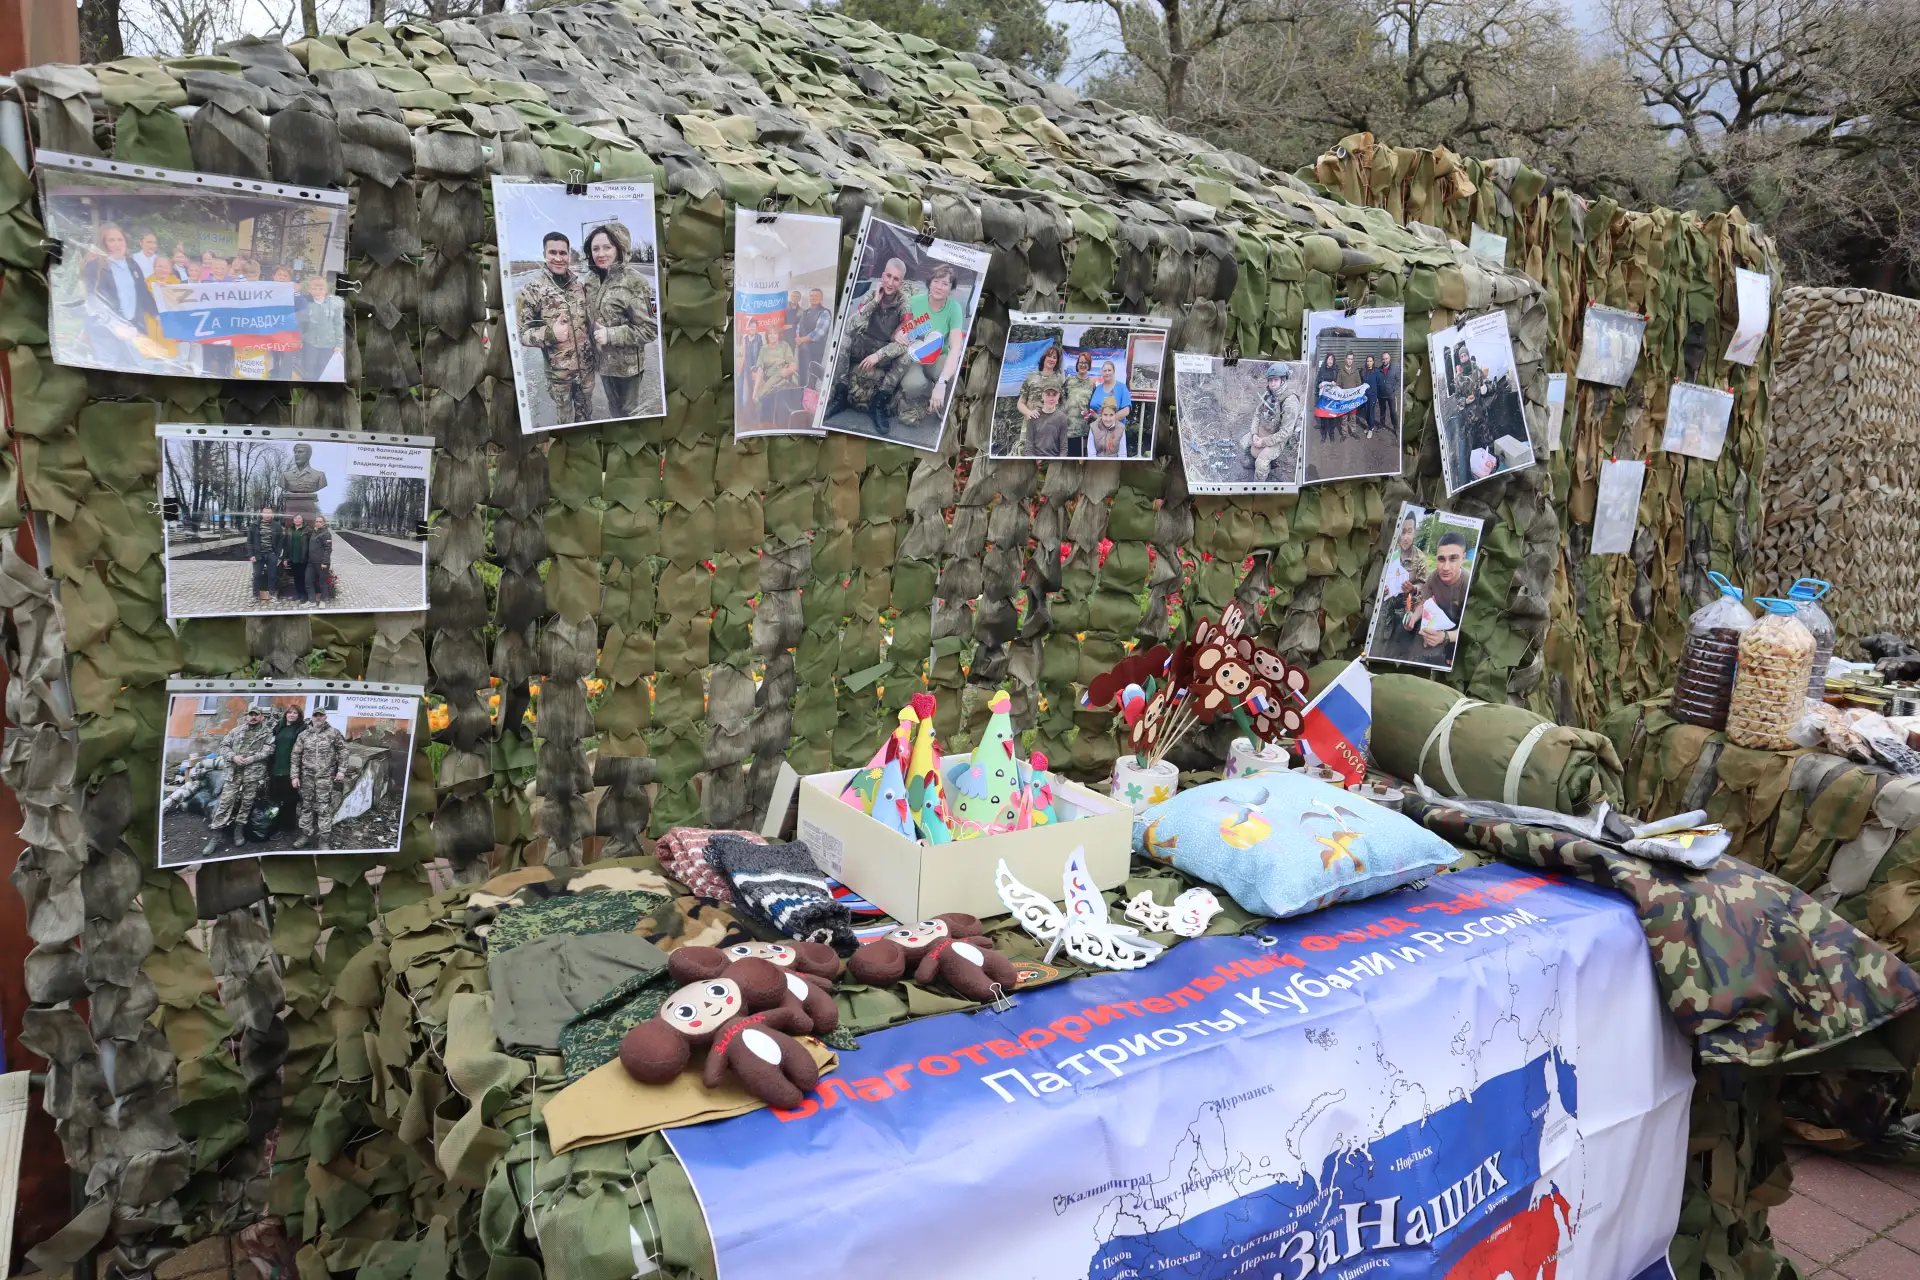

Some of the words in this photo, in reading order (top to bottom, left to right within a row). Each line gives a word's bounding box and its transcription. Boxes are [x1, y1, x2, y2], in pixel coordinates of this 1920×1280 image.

[214, 288, 274, 301] НАШИХ
[230, 314, 285, 329] ПРАВДУ!
[900, 321, 914, 335] ЭТО
[914, 312, 931, 327] МОЯ
[353, 460, 387, 468] Владимиру
[980, 1006, 1248, 1104] Патриоты
[1234, 951, 1397, 1015] Кубани
[1389, 946, 1427, 963] и
[1214, 1082, 1275, 1113] Мурманск
[1066, 1172, 1154, 1206] Калининград
[1230, 1219, 1299, 1259] Сыктывкар
[1102, 1250, 1132, 1271] Псков
[1157, 1250, 1201, 1271] Москва
[1240, 1251, 1276, 1274] Пермь
